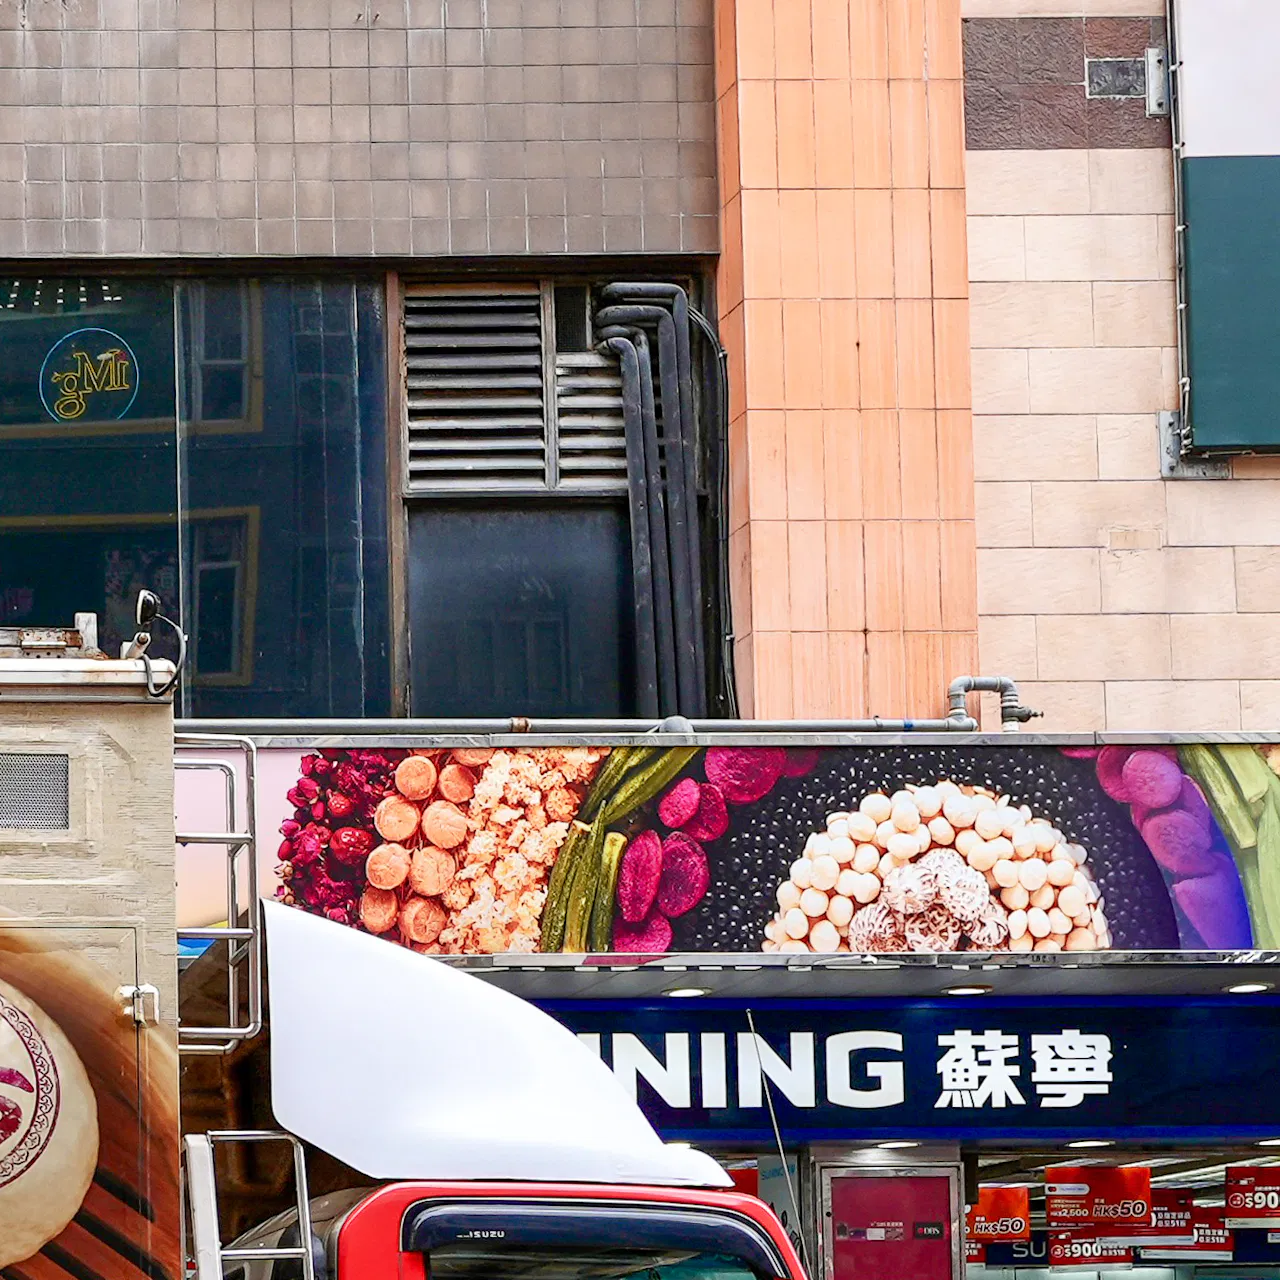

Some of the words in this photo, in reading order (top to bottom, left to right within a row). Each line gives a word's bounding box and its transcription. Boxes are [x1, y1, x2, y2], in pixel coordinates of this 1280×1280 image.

[576, 1030, 904, 1108] NING
[934, 1029, 1114, 1108] 蘇寧
[974, 1217, 1025, 1234] HK$50
[1092, 1200, 1147, 1218] HK$50
